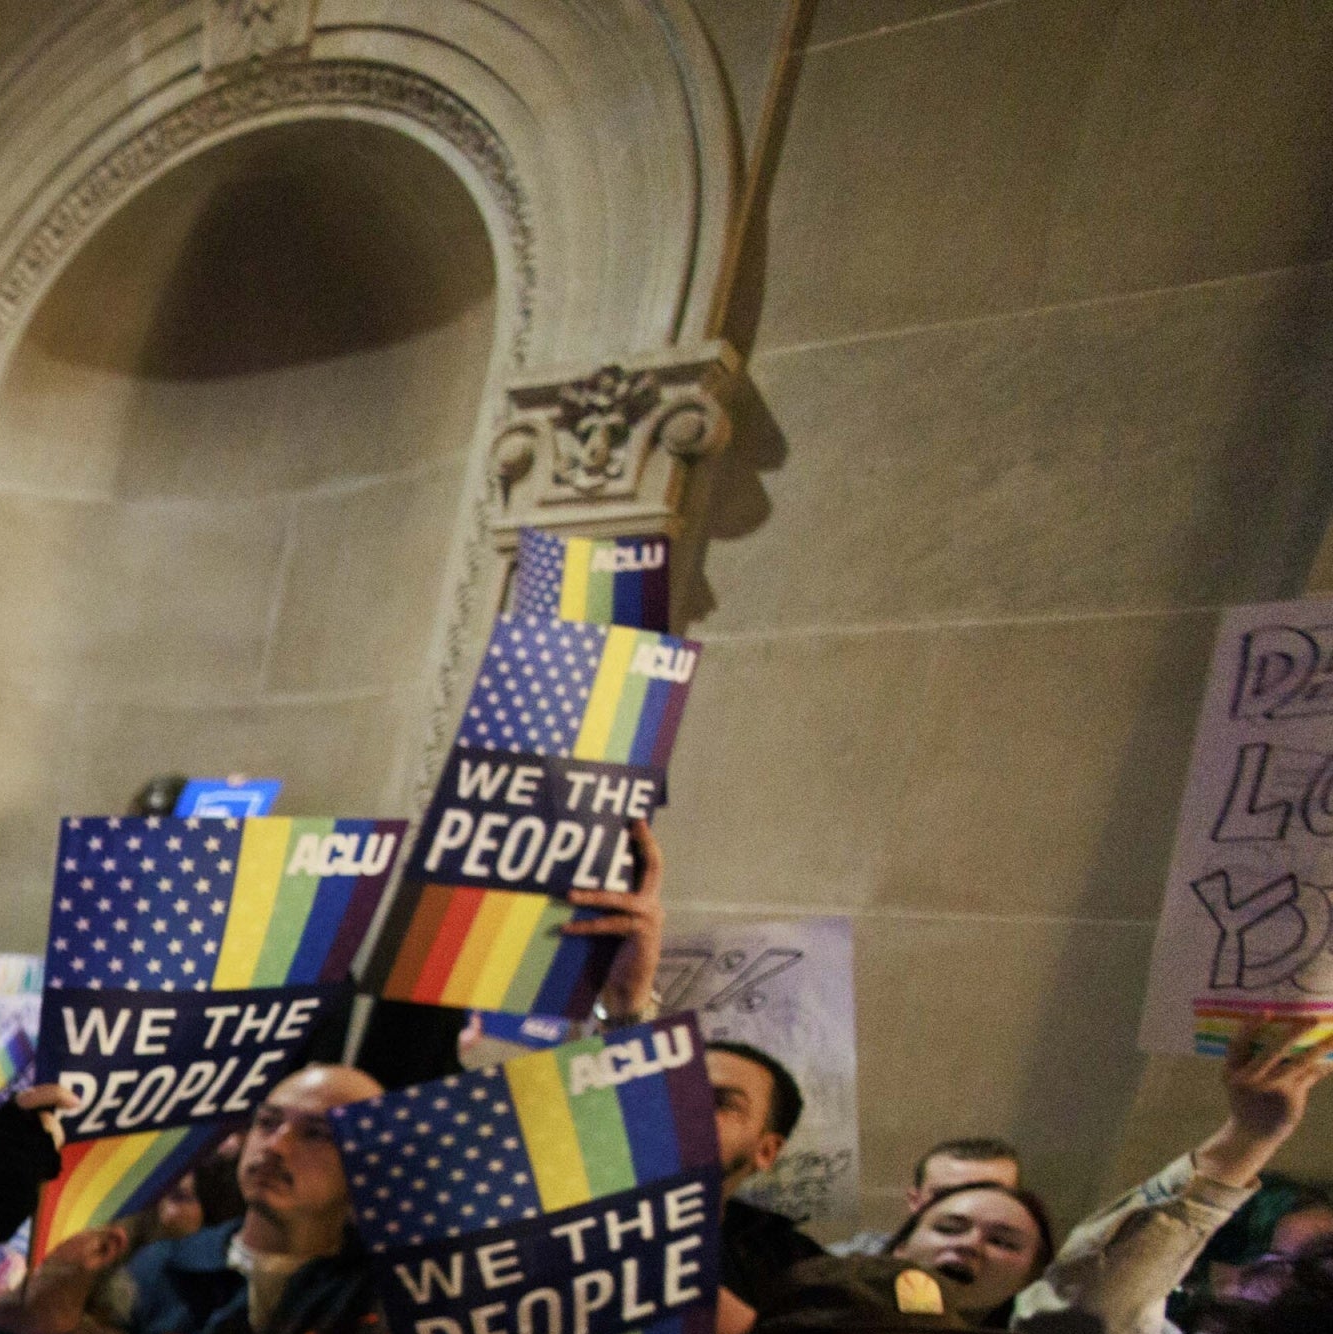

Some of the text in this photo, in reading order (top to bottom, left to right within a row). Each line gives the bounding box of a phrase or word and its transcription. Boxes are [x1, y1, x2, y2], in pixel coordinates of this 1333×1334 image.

[630, 642, 697, 685] ACLU
[455, 757, 655, 820] WE THE
[286, 832, 398, 877] ACLU
[422, 806, 633, 893] PEOPLE
[61, 997, 321, 1057] WE THE
[569, 1025, 694, 1096] ACLU
[56, 1048, 286, 1134] PEOPLE
[395, 1182, 706, 1306] WE THE
